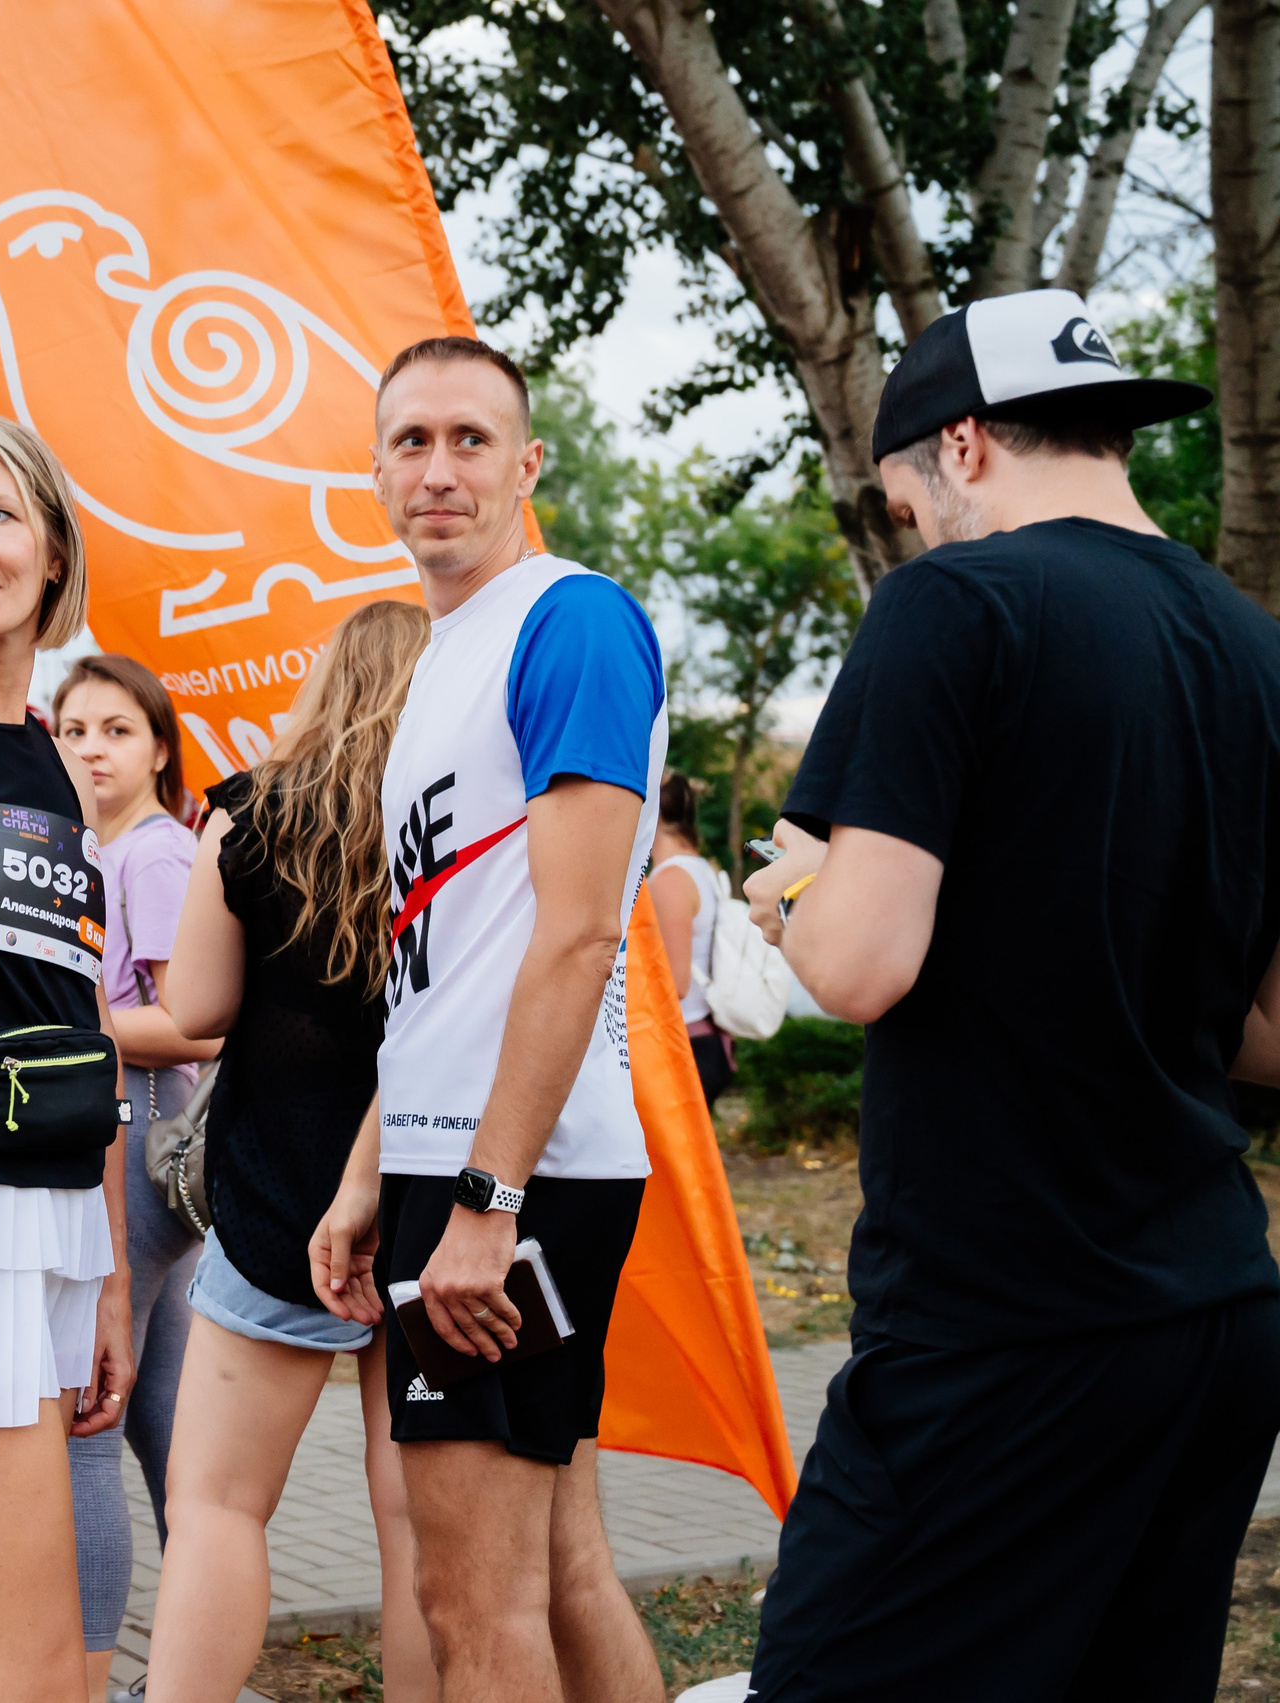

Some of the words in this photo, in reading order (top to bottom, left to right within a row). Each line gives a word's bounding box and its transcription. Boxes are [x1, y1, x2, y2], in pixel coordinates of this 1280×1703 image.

[10, 809, 29, 821] НЕ
[2, 817, 49, 837] СПАТЬ!
[2, 848, 89, 904] 5032
[0, 897, 81, 933] Александрова
[406, 1390, 445, 1401] adidas
